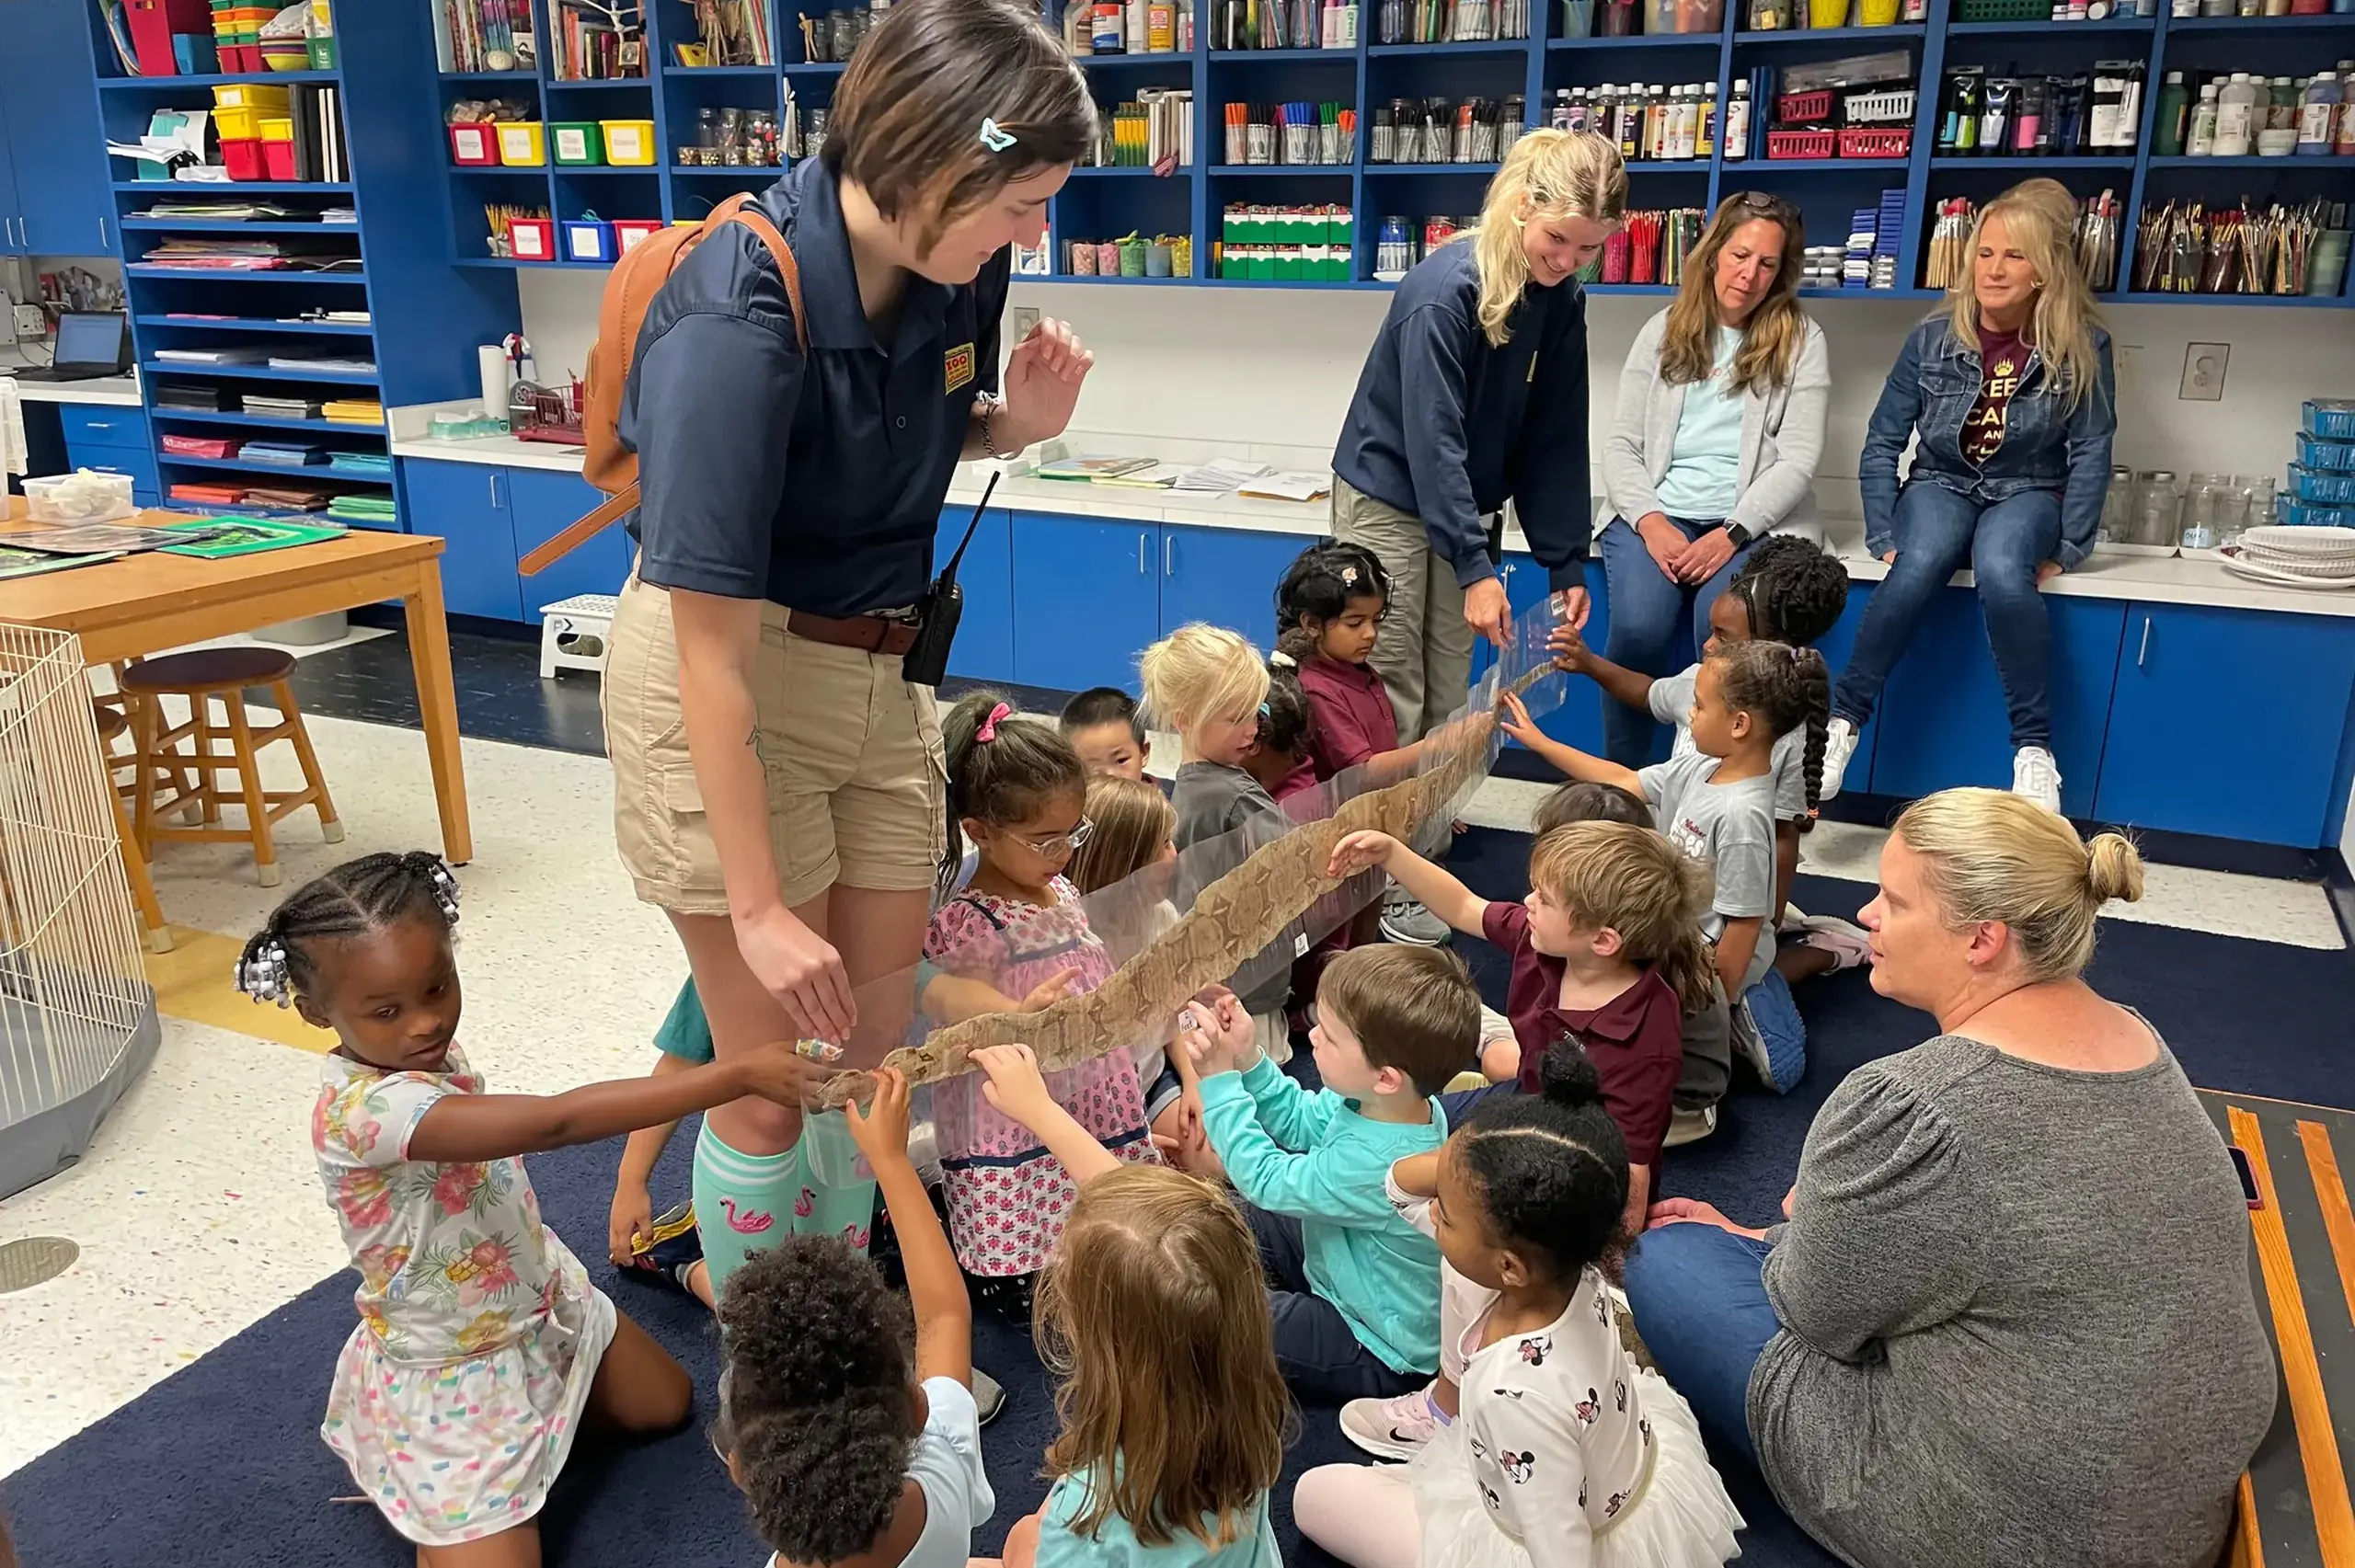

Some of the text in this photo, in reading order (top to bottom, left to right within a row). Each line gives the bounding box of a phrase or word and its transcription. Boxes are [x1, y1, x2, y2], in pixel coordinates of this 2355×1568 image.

[946, 356, 967, 371] ZOO
[1981, 378, 2017, 397] KEE
[1966, 406, 2007, 426] CA
[1983, 429, 2003, 441] AN
